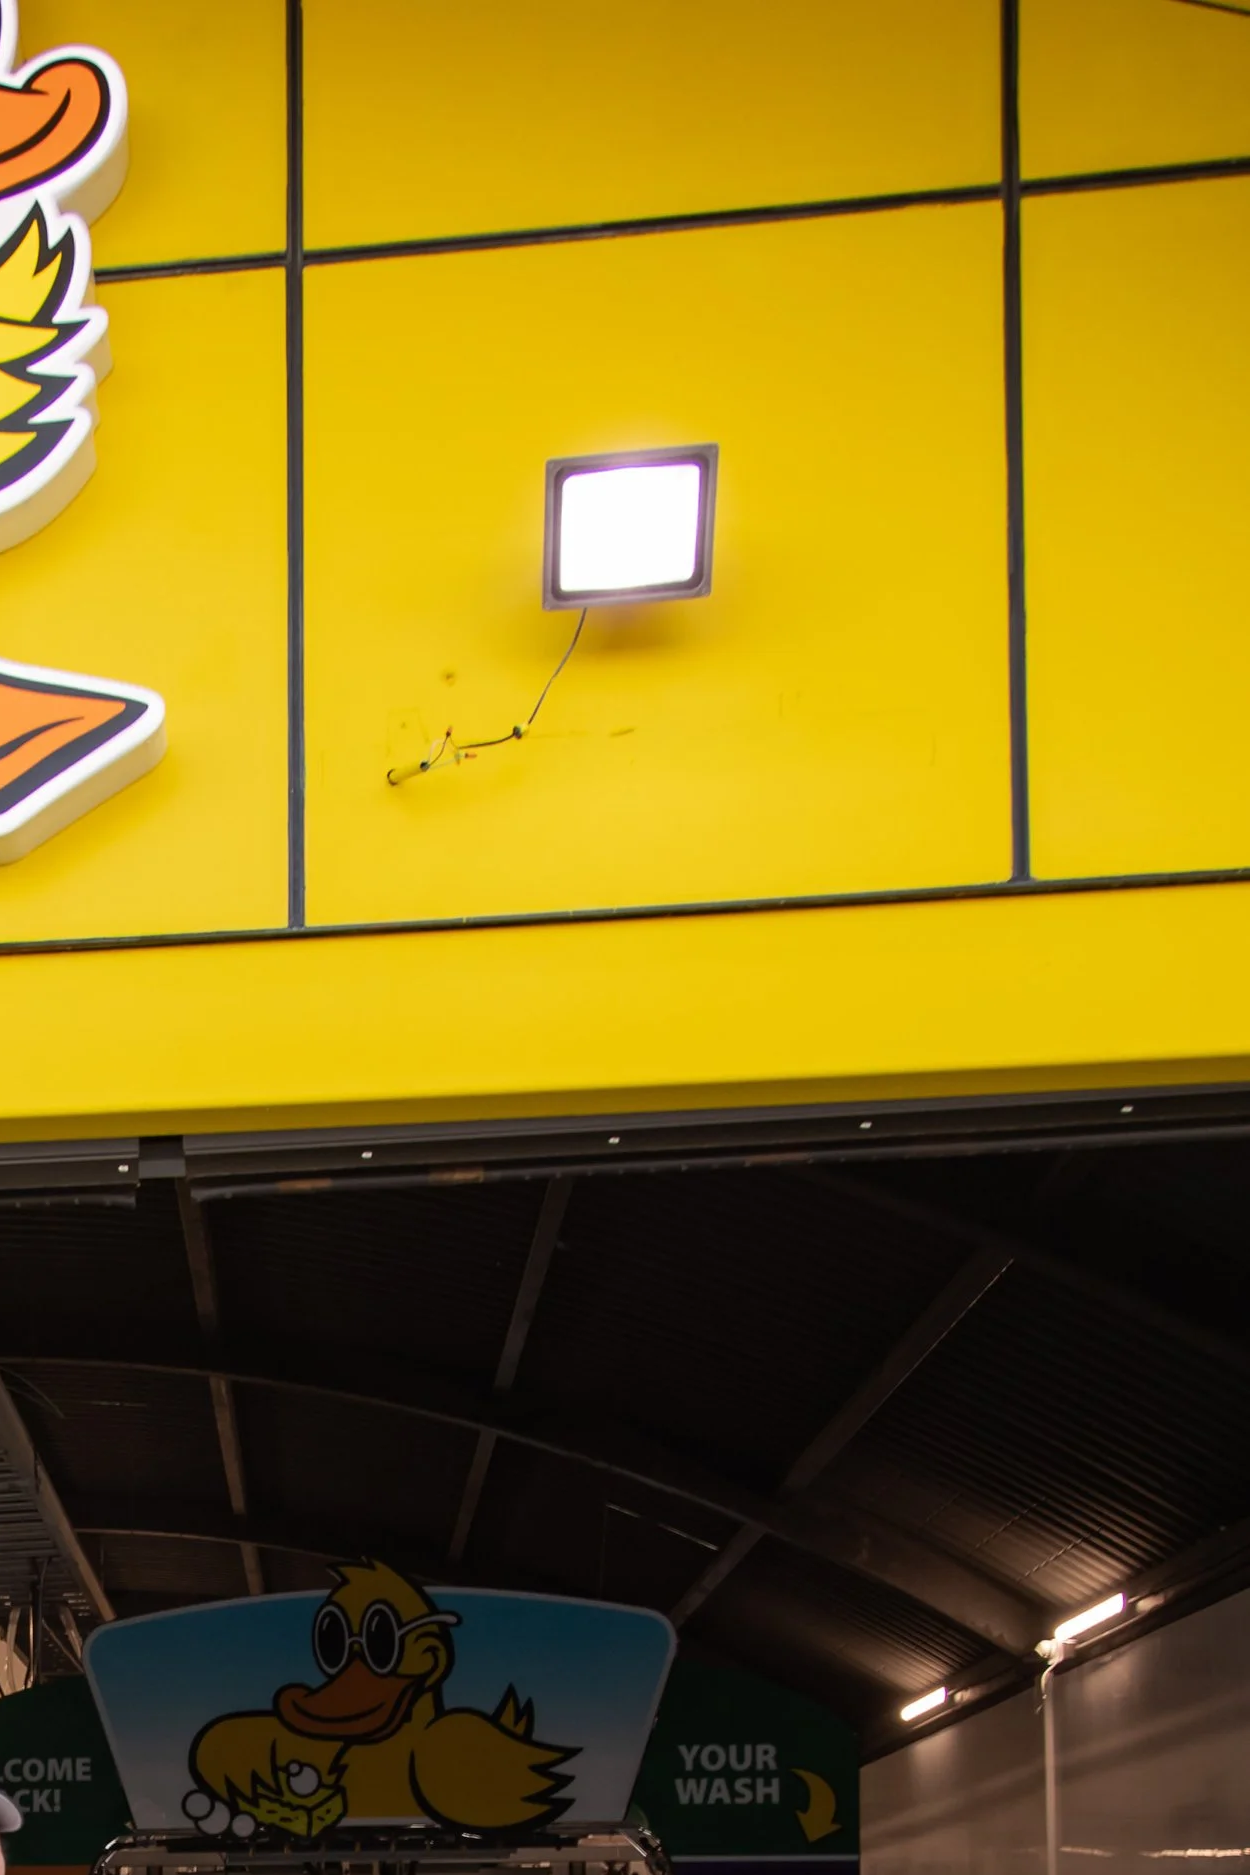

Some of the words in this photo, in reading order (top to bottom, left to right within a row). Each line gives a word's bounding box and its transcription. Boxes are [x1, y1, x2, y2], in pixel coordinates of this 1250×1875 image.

[676, 1743, 778, 1771] YOUR
[12, 1788, 62, 1813] CK!
[674, 1776, 780, 1805] WASH
